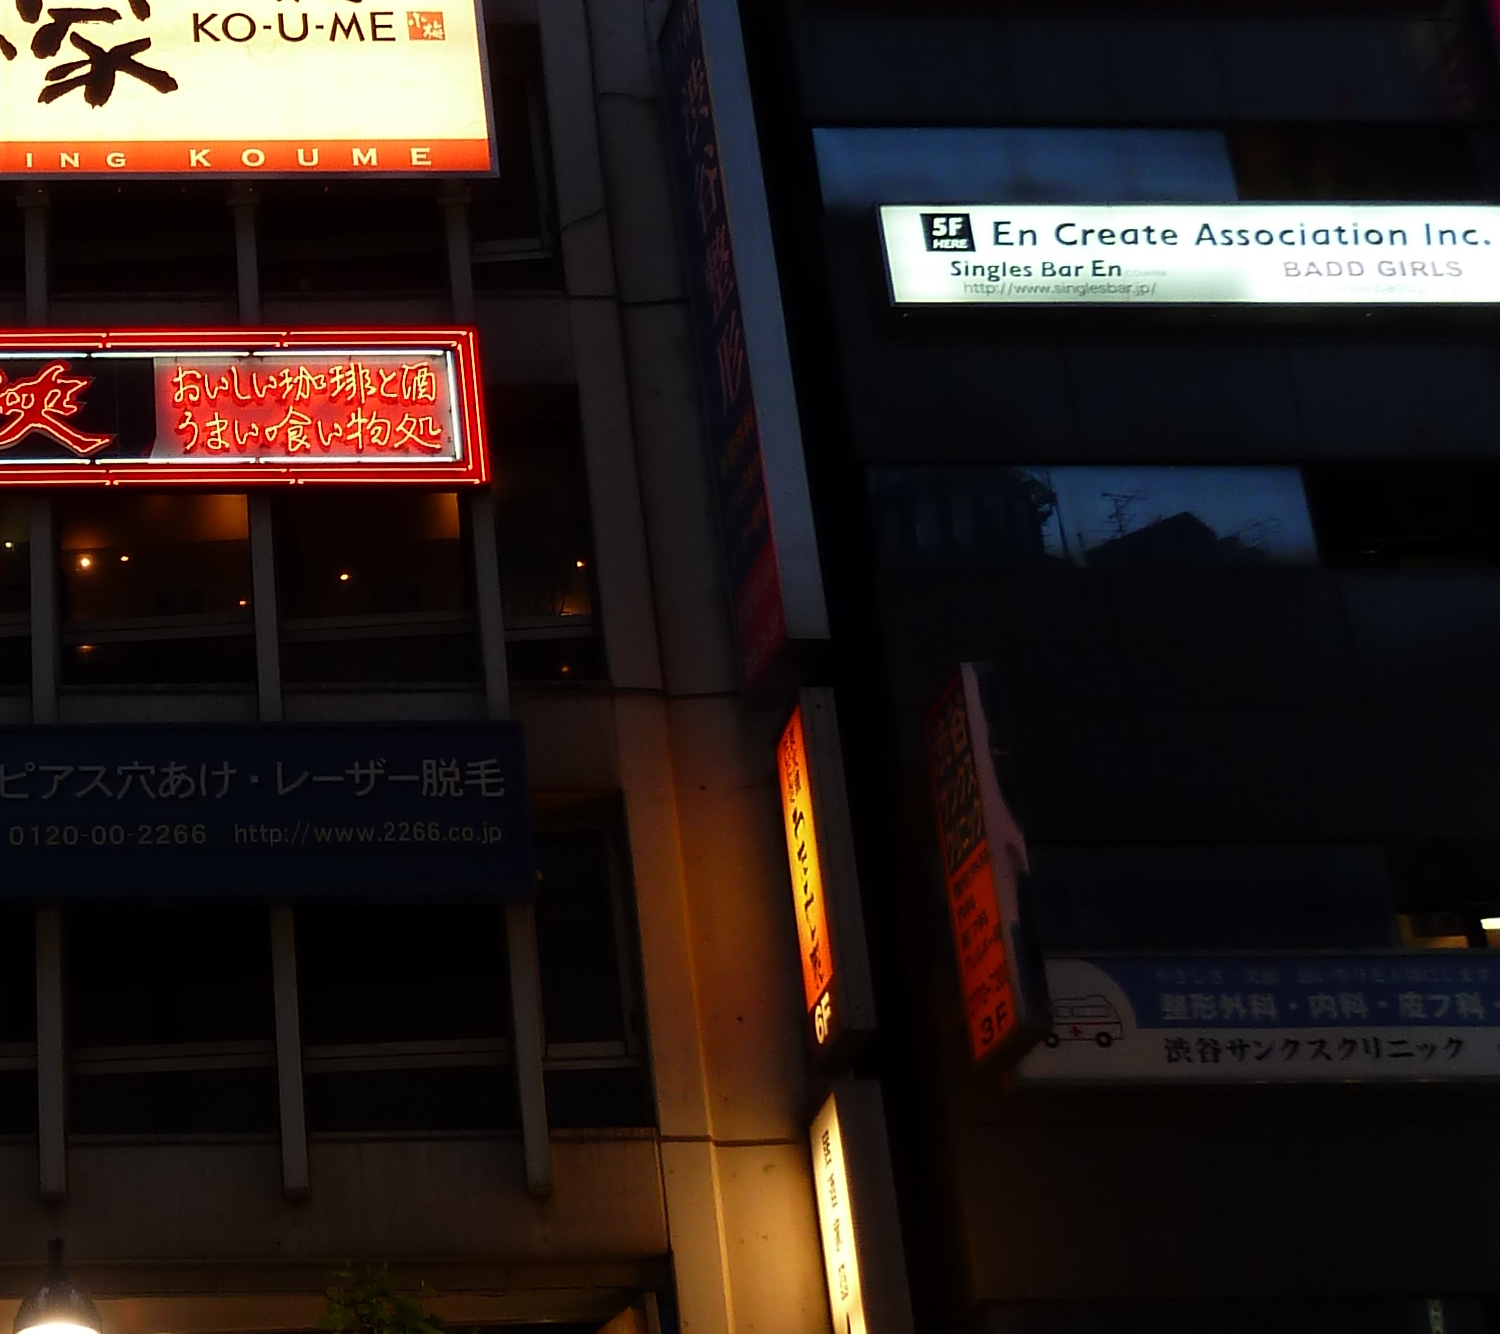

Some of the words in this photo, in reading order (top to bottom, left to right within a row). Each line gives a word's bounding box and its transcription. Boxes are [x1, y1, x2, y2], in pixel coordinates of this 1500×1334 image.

[190, 9, 398, 44] KO-U-ME
[190, 147, 434, 170] KOUME
[931, 217, 964, 238] 5F
[991, 221, 1038, 246] En
[1053, 220, 1180, 247] Create
[1194, 220, 1408, 247] Association
[1425, 222, 1492, 246] Inc.
[932, 239, 970, 250] HERE
[949, 260, 1033, 282] Singles
[1041, 260, 1084, 277] Bar
[1091, 260, 1123, 277] En
[1283, 260, 1366, 279] BADD
[1376, 260, 1464, 279] GIRLS
[172, 361, 438, 405] おいしい珈琲と酒
[178, 405, 443, 453] うまい喰い物処
[8, 821, 208, 848] 0120-00-2266
[232, 818, 504, 848] http://www.2266.co.jp
[814, 990, 832, 1046] 6F
[980, 999, 1008, 1048] 3F
[1164, 1035, 1466, 1065] 渋谷サンクスクリニック
